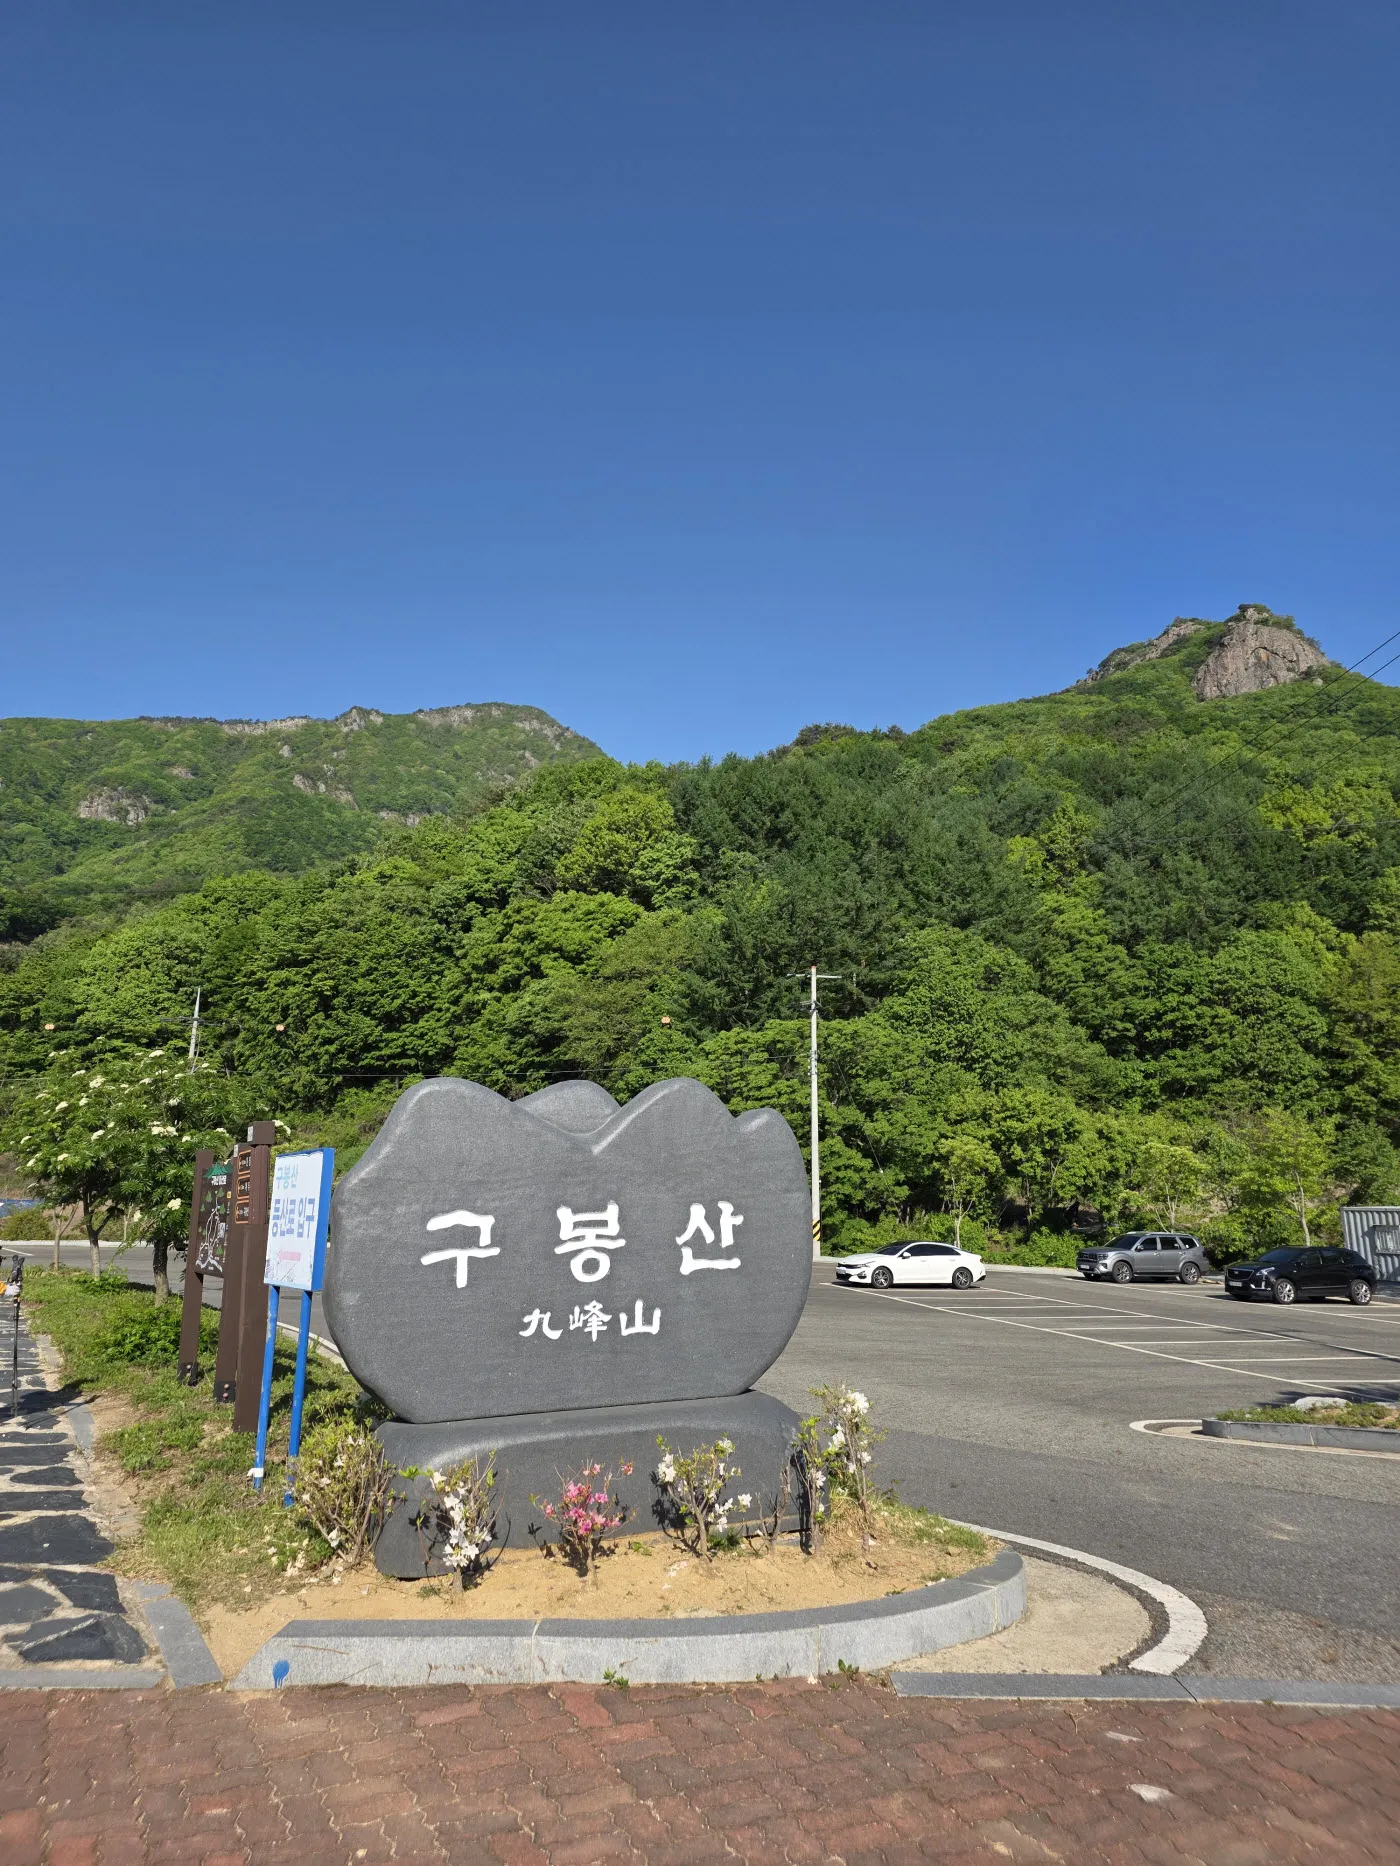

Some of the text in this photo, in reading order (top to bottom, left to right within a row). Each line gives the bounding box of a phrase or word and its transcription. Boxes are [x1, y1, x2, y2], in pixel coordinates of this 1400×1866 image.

[276, 1164, 299, 1190] 구봉산
[272, 1197, 297, 1238] 등산로
[297, 1196, 316, 1239] 입구
[420, 1200, 744, 1289] 구봉산
[518, 1299, 662, 1342] 九峰山
